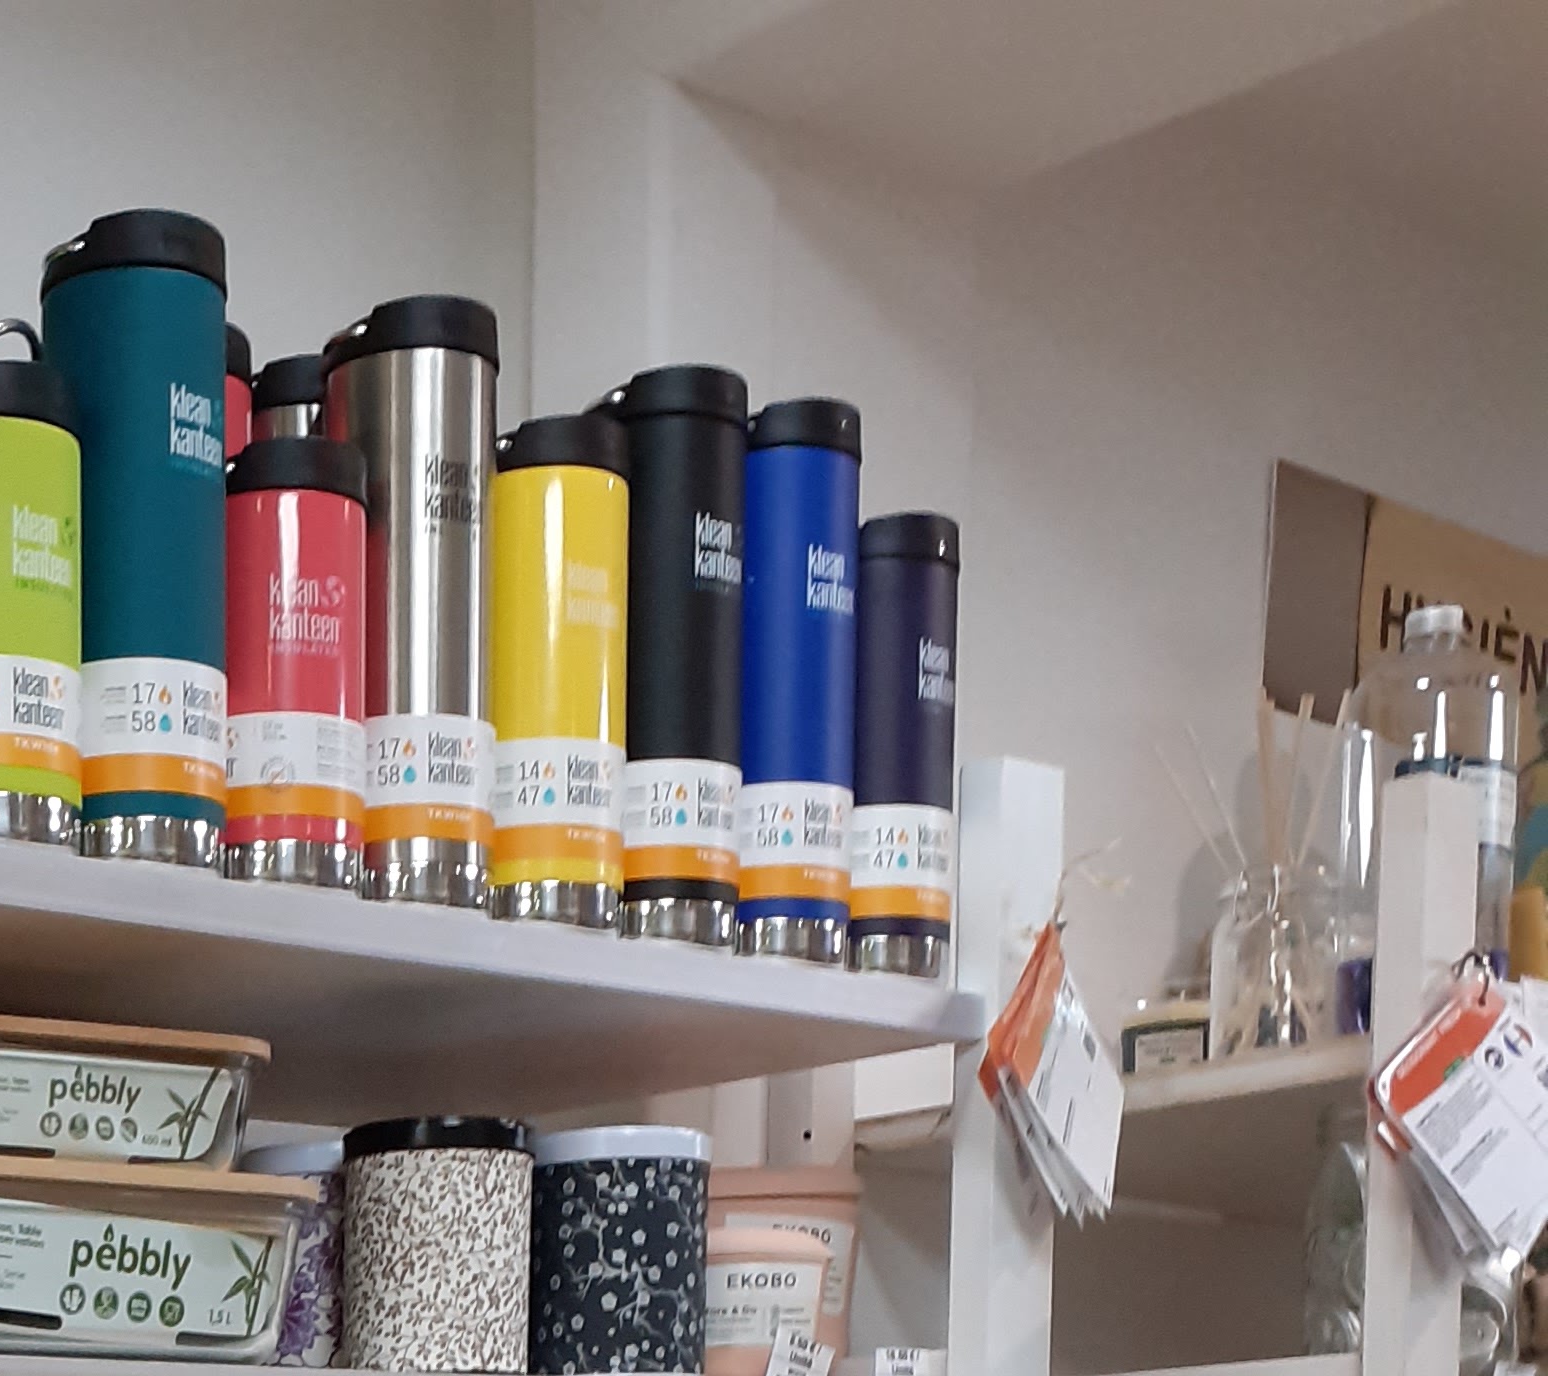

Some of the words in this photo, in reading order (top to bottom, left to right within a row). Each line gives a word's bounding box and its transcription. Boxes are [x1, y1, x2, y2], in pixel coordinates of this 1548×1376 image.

[170, 383, 211, 423] klean
[170, 420, 222, 467] kanteen
[695, 511, 732, 546] klean
[809, 544, 845, 580] klean
[269, 604, 340, 643] kanteen
[132, 682, 155, 704] 17
[131, 711, 156, 732] 58
[378, 738, 399, 758] 17
[377, 763, 400, 785] 58
[517, 787, 540, 806] 47
[653, 783, 673, 800] 17
[726, 1272, 797, 1289] EKOBO
